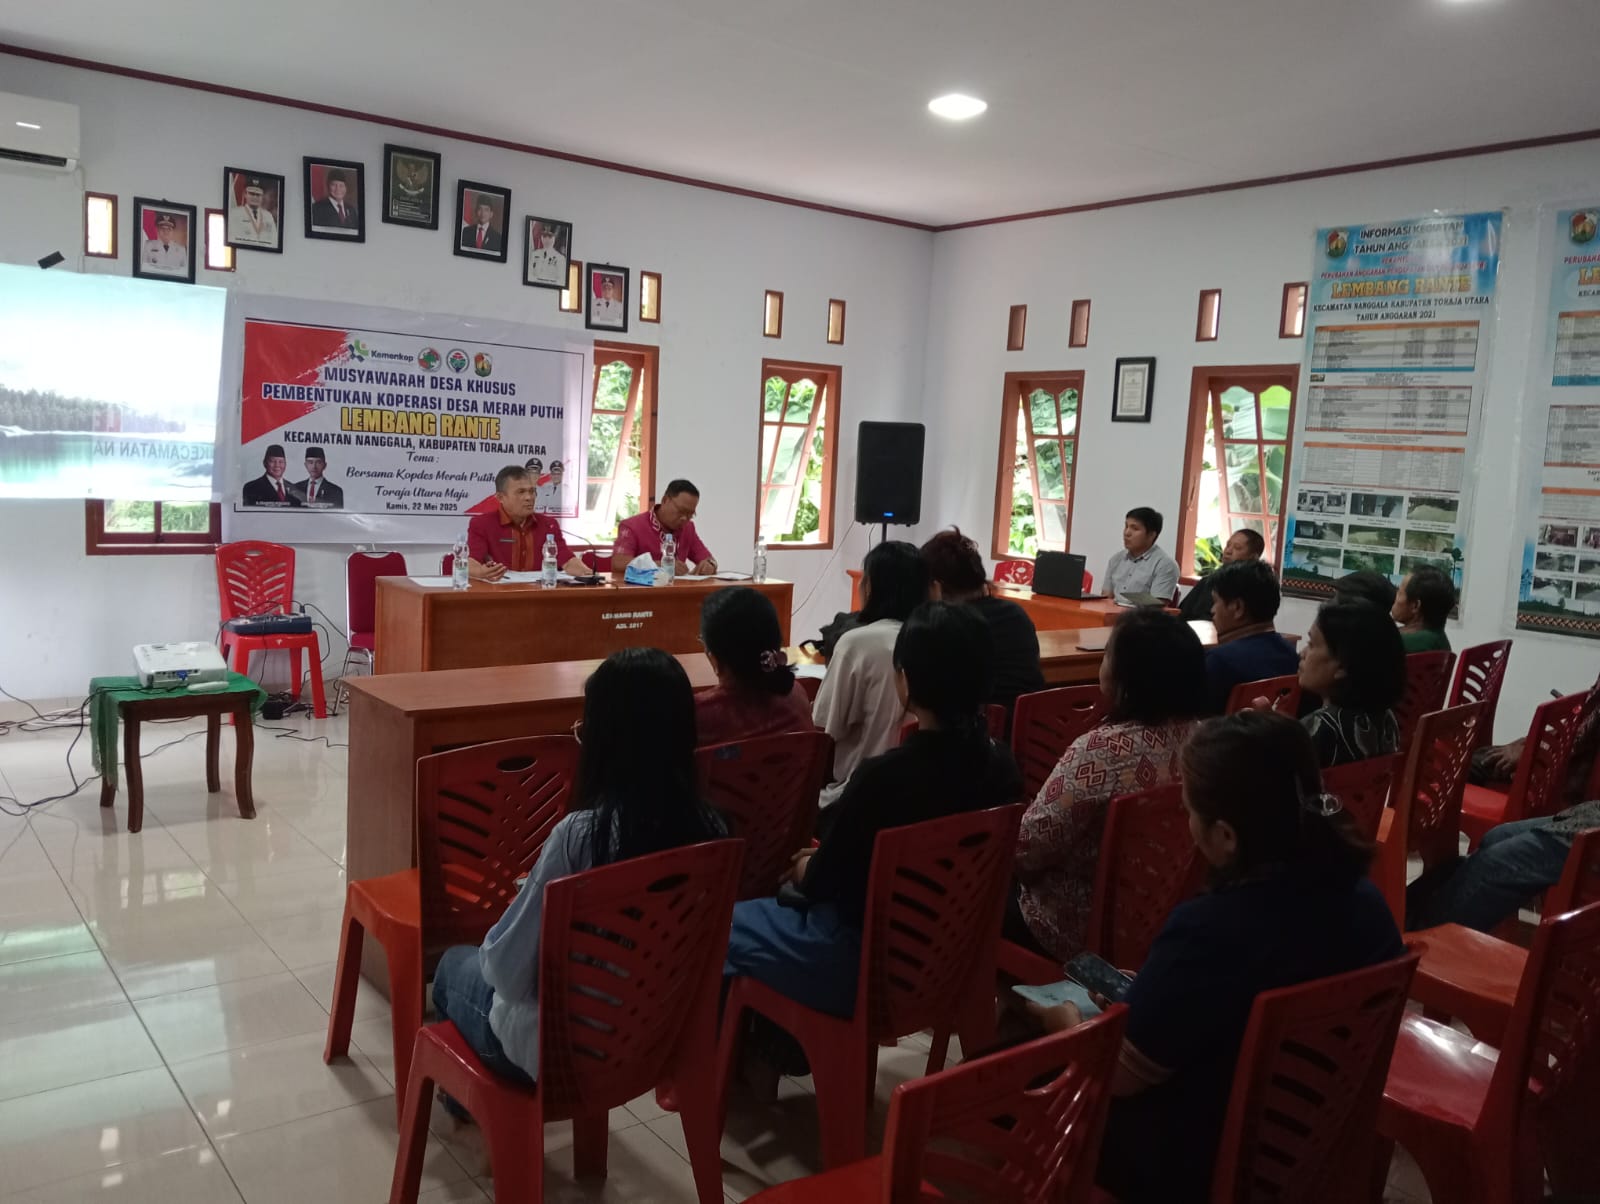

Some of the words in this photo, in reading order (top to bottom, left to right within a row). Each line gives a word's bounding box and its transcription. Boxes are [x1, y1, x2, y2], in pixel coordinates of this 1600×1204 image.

[1360, 226, 1411, 239] INFORMASI
[1354, 243, 1386, 254] TAHUN
[1331, 279, 1410, 299] LEMBANG
[1415, 274, 1472, 295] RANTE
[1313, 303, 1351, 312] KECAMATAN
[1353, 301, 1388, 310] NANGGALA
[1434, 296, 1462, 306] TORAJA
[1464, 295, 1490, 305] UTARA
[1356, 313, 1378, 321] TAHUN
[1380, 311, 1417, 320] ANGGARAN
[1419, 310, 1436, 319] 2021
[371, 350, 413, 362] Kemenkop
[324, 366, 425, 389] MUSYAWARAH
[430, 375, 463, 392] DESA
[467, 379, 516, 396] KHUSUS
[262, 383, 372, 406] PEMBENTUKAN
[377, 393, 441, 411] KOPERASI
[447, 398, 478, 413] DESA
[483, 401, 526, 417] MERAH
[530, 405, 564, 419] PUTIH
[341, 407, 437, 436] LEMBANG
[440, 413, 501, 440] RANTE
[284, 431, 352, 446] KECAMATAN
[355, 435, 415, 450] NANGGALA,
[419, 438, 476, 452] KABUPATEN
[479, 441, 514, 454] TORAJA
[518, 444, 547, 456] UTARA
[406, 451, 434, 463] Tema
[346, 466, 393, 478] Bersama
[396, 468, 433, 482] Kopdes
[436, 470, 467, 482] Merah
[470, 471, 496, 483] Putih
[374, 485, 410, 499] Toraja
[413, 487, 442, 498] Utara
[444, 488, 469, 501] Maju
[386, 502, 410, 511] Kamis,
[412, 502, 421, 511] 22
[424, 502, 437, 511] Mei
[440, 502, 457, 511] 2025
